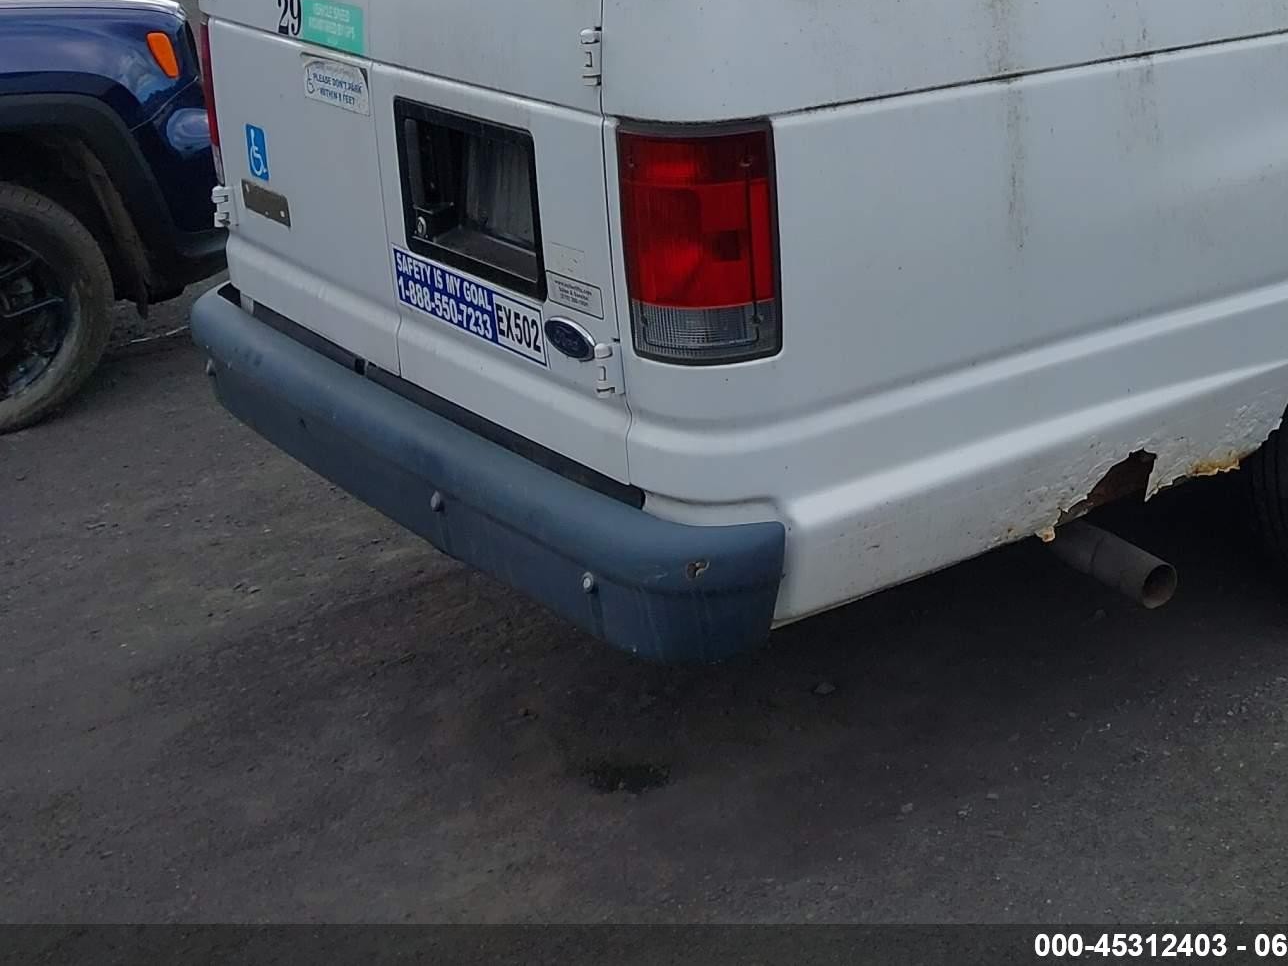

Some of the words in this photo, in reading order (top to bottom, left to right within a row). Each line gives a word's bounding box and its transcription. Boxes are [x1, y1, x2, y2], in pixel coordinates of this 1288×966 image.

[312, 73, 331, 86] PLEASE
[343, 93, 356, 106] FEET
[396, 251, 431, 284] SAFETY
[433, 267, 444, 290] IS
[445, 273, 462, 298] MY
[463, 283, 492, 312] GOAL
[398, 275, 493, 340] 1-888-550-7233
[495, 302, 542, 354] EX502
